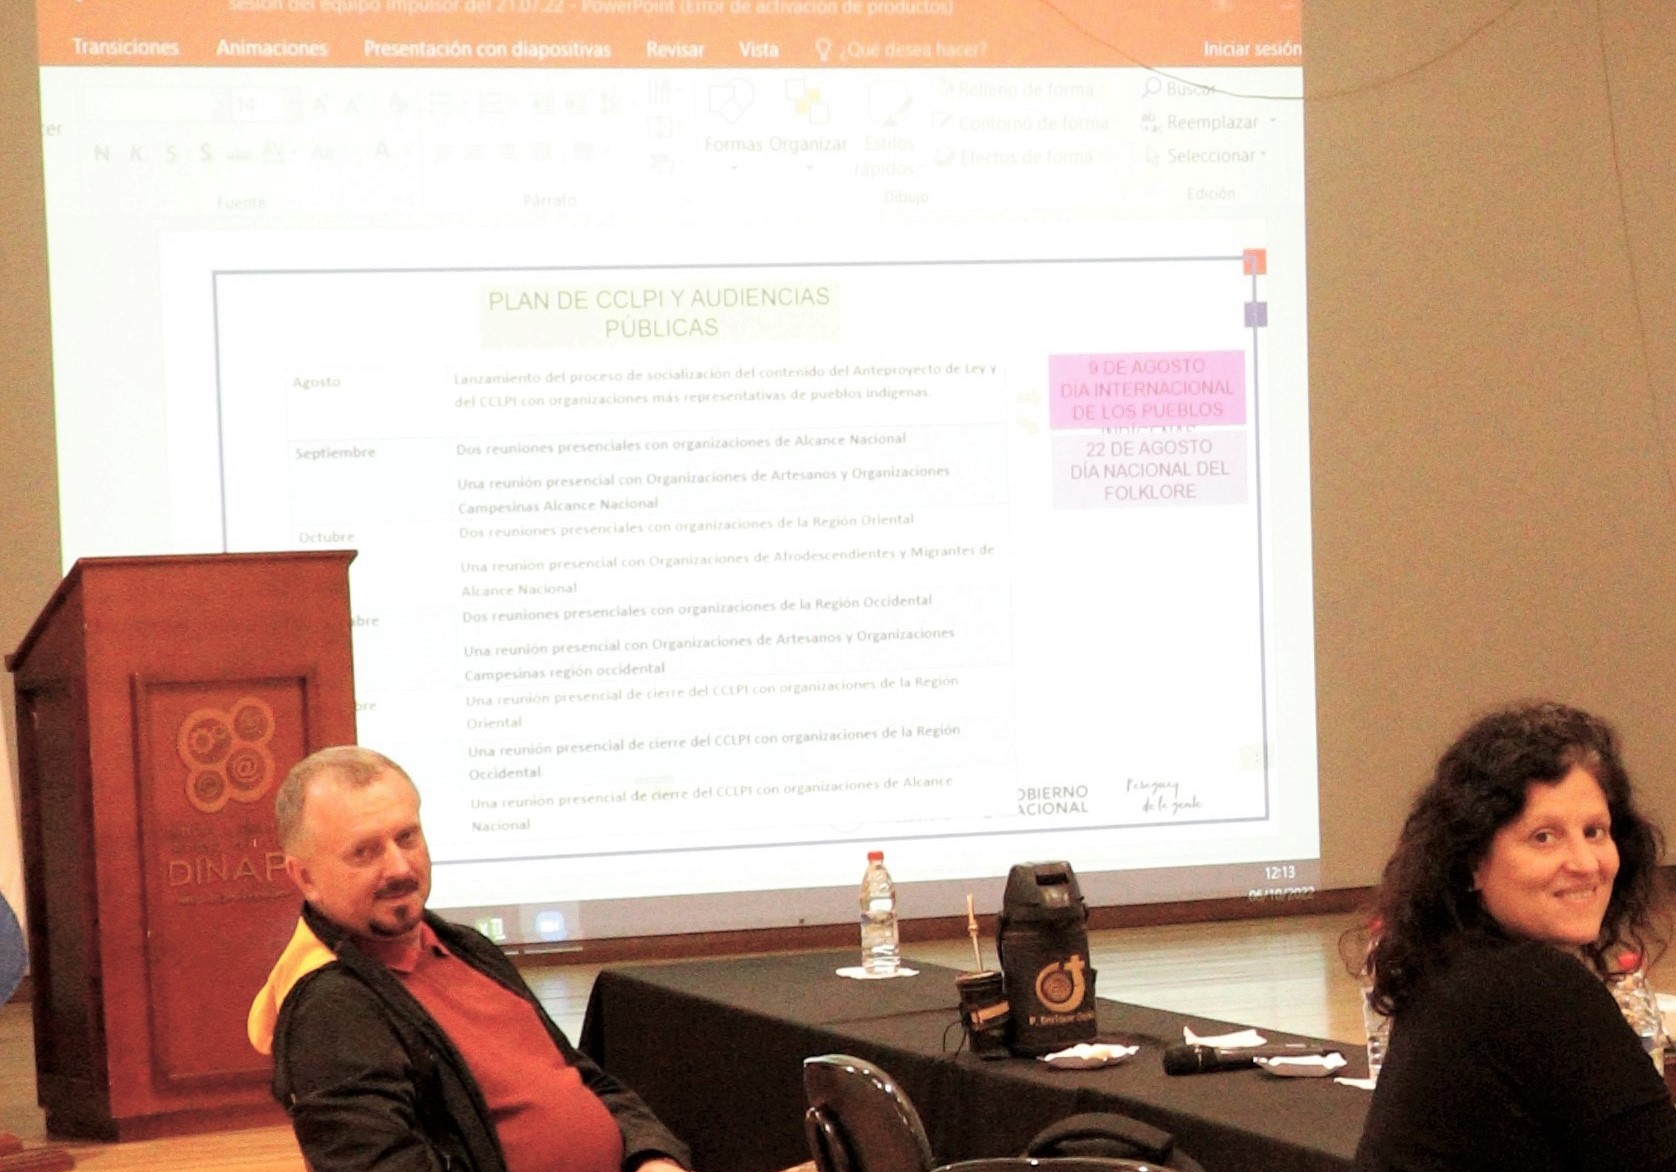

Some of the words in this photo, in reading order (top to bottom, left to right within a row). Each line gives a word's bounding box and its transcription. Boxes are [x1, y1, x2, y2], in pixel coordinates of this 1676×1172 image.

[73, 38, 180, 56] Transiciones
[217, 38, 329, 57] Animaciones
[364, 39, 473, 57] Presentación
[476, 44, 508, 58] con
[511, 41, 612, 61] diapositivas
[646, 40, 705, 58] Revisar
[739, 40, 780, 58] Vista
[884, 41, 932, 57] desea
[936, 40, 987, 57] hacer?
[1204, 41, 1250, 56] Iniciar
[1255, 40, 1303, 57] sesión
[1167, 113, 1259, 133] Reemplazar
[705, 136, 765, 153] Formas
[768, 136, 848, 155] Organizar
[1168, 147, 1256, 163] Seleccionar
[489, 289, 550, 312] PLAN
[558, 290, 589, 311] DE
[596, 289, 664, 310] CCLPI
[670, 289, 685, 307] Y
[690, 287, 830, 307] AUDIENCIAS
[606, 314, 720, 338] PÚBLICAS
[454, 372, 542, 384] Lanzamiento
[544, 371, 566, 383] del
[570, 373, 623, 384] proceso
[627, 369, 643, 381] de
[647, 368, 731, 380] socialización
[735, 367, 756, 379] del
[759, 365, 825, 378] contenido
[829, 366, 849, 377] del
[853, 365, 942, 378] Anteproyecto
[945, 363, 961, 375] de
[965, 363, 986, 375] Ley
[990, 365, 996, 374] y
[1103, 359, 1127, 376] DE
[1131, 358, 1206, 374] AGOSTO
[293, 376, 341, 390] Agosto
[1093, 380, 1234, 397] INTERNACIONAL
[455, 395, 476, 408] del
[479, 396, 517, 408] CCLPI
[521, 397, 545, 406] con
[549, 394, 648, 408] organizaciones
[684, 390, 787, 403] representativas
[790, 389, 806, 401] de
[811, 388, 862, 401] pueblos
[1072, 404, 1096, 421] DE
[1101, 403, 1137, 420] LOS
[1141, 401, 1224, 418] PUEBLOS
[296, 446, 376, 460] Septiembre
[456, 444, 482, 455] Dos
[486, 443, 554, 454] reuniones
[558, 440, 641, 454] presenciales
[645, 442, 668, 451] con
[672, 436, 771, 451] organizaciones
[774, 436, 791, 447] de
[794, 434, 846, 446] Alcance
[849, 433, 907, 445] Nacional
[1086, 442, 1105, 458] 22
[1111, 440, 1134, 457] DE
[1138, 439, 1213, 455] AGOSTO
[458, 478, 485, 490] Una
[489, 476, 542, 488] reunión
[546, 475, 615, 489] presencial
[618, 476, 642, 485] con
[646, 471, 747, 486] Organizaciones
[751, 470, 767, 482] de
[771, 470, 837, 481] Artesanos
[841, 471, 848, 481] y
[852, 466, 950, 480] Organizaciones
[1104, 462, 1192, 478] NACIONAL
[1197, 460, 1230, 476] DEL
[1104, 483, 1196, 500] FOLKLORE
[458, 502, 539, 515] Campesinas
[544, 499, 596, 511] Alcance
[600, 497, 659, 510] Nacional
[299, 530, 354, 544] Octubre
[461, 562, 488, 573] Una
[492, 561, 545, 572] reunión
[549, 558, 618, 571] presencial
[621, 559, 645, 567] con
[649, 554, 750, 568] Organizaciones
[754, 552, 770, 563] de
[774, 548, 896, 560] Afrodescendientes
[899, 550, 906, 559] y
[910, 546, 975, 559] Migrantes
[979, 544, 994, 556] de
[462, 585, 514, 597] Alcance
[518, 583, 577, 595] Nacional
[462, 612, 488, 623] Dos
[492, 609, 560, 621] reuniones
[563, 606, 647, 620] presenciales
[650, 607, 674, 615] con
[678, 602, 776, 616] organizaciones
[780, 599, 796, 611] de
[800, 598, 811, 610] la
[815, 597, 860, 611] Región
[863, 594, 932, 607] Occidental
[464, 646, 491, 657] Una
[495, 643, 548, 655] reunión
[552, 641, 621, 655] presencial
[624, 642, 648, 651] con
[652, 637, 752, 651] Organizaciones
[756, 633, 772, 645] de
[776, 633, 842, 644] Artesanos
[845, 633, 853, 643] y
[857, 627, 955, 642] Organizaciones
[465, 668, 546, 682] Campesinas
[550, 666, 593, 679] región
[597, 662, 665, 675] occidental
[467, 716, 523, 729] Oriental
[468, 746, 496, 757] Una
[500, 743, 552, 755] reunión
[556, 740, 625, 754] presencial
[628, 738, 644, 750] de
[649, 737, 686, 749] cierre
[690, 735, 711, 748] del
[714, 734, 751, 746] CCLPI
[754, 736, 778, 745] con
[782, 730, 878, 744] organizaciones
[882, 726, 898, 738] de
[901, 725, 913, 737] la
[916, 724, 960, 739] Región
[469, 766, 542, 780] Occidental
[471, 799, 498, 809] Una
[502, 795, 554, 807] reunión
[559, 792, 627, 806] presencial
[630, 789, 647, 802] de
[651, 787, 688, 801] cierre
[693, 786, 713, 798] del
[716, 786, 752, 797] CCLPI
[756, 786, 779, 795] con
[784, 780, 879, 794] organizaciones
[884, 778, 899, 789] de
[904, 776, 952, 787] Alcance
[472, 818, 531, 831] Nacional
[1265, 865, 1296, 880] 12:13
